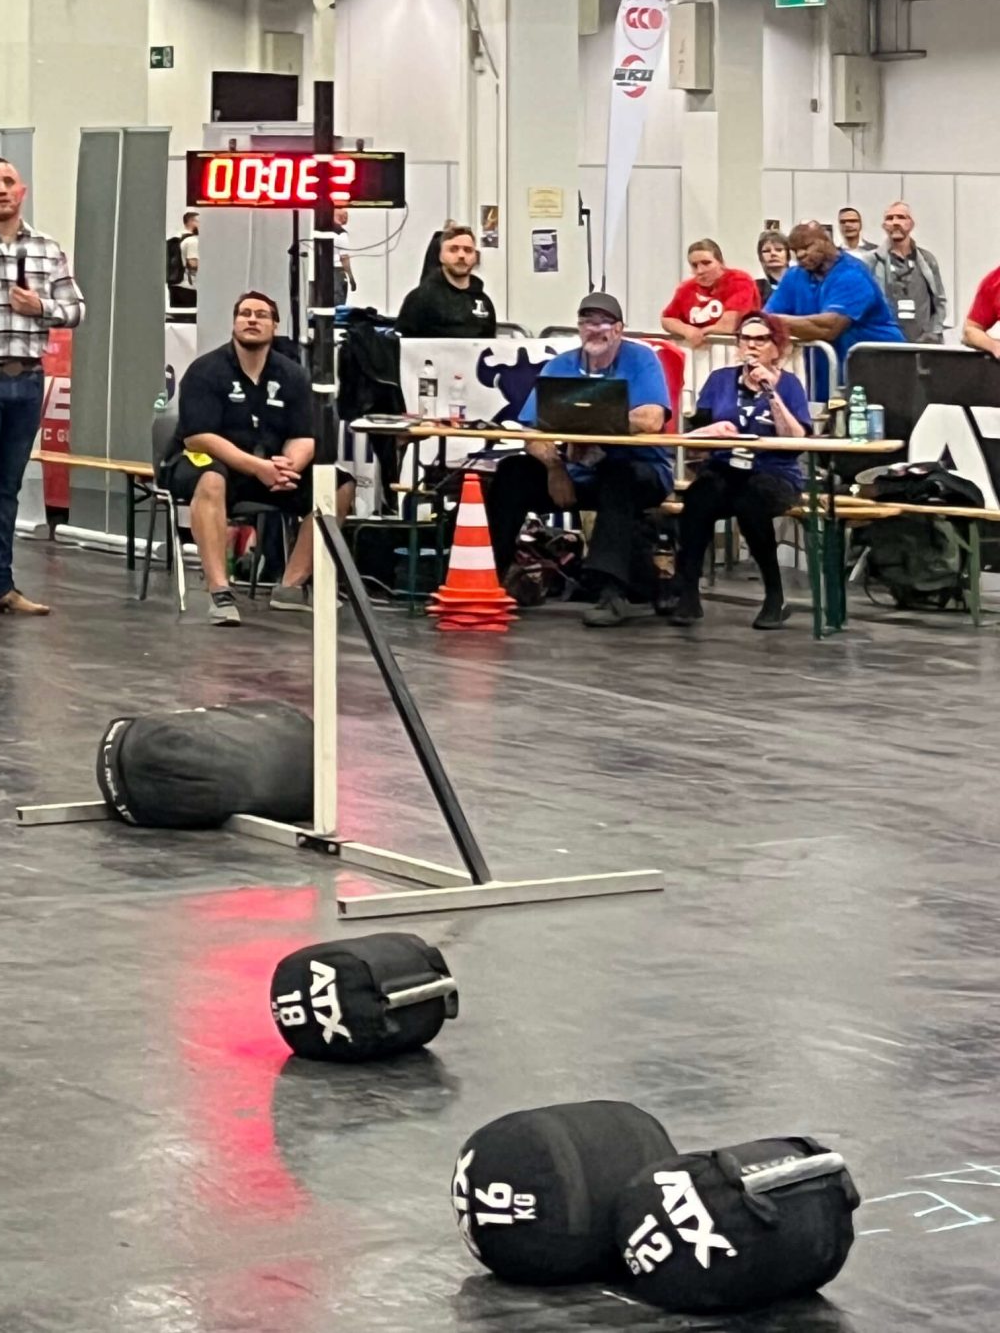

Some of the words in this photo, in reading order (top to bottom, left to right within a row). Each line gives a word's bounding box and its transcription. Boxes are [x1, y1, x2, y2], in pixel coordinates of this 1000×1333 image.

[277, 990, 307, 1027] 18
[310, 960, 352, 1044] ATX
[475, 1182, 514, 1226] 16
[513, 1193, 538, 1220] KG
[653, 1170, 732, 1269] ATX
[628, 1213, 673, 1273] 12
